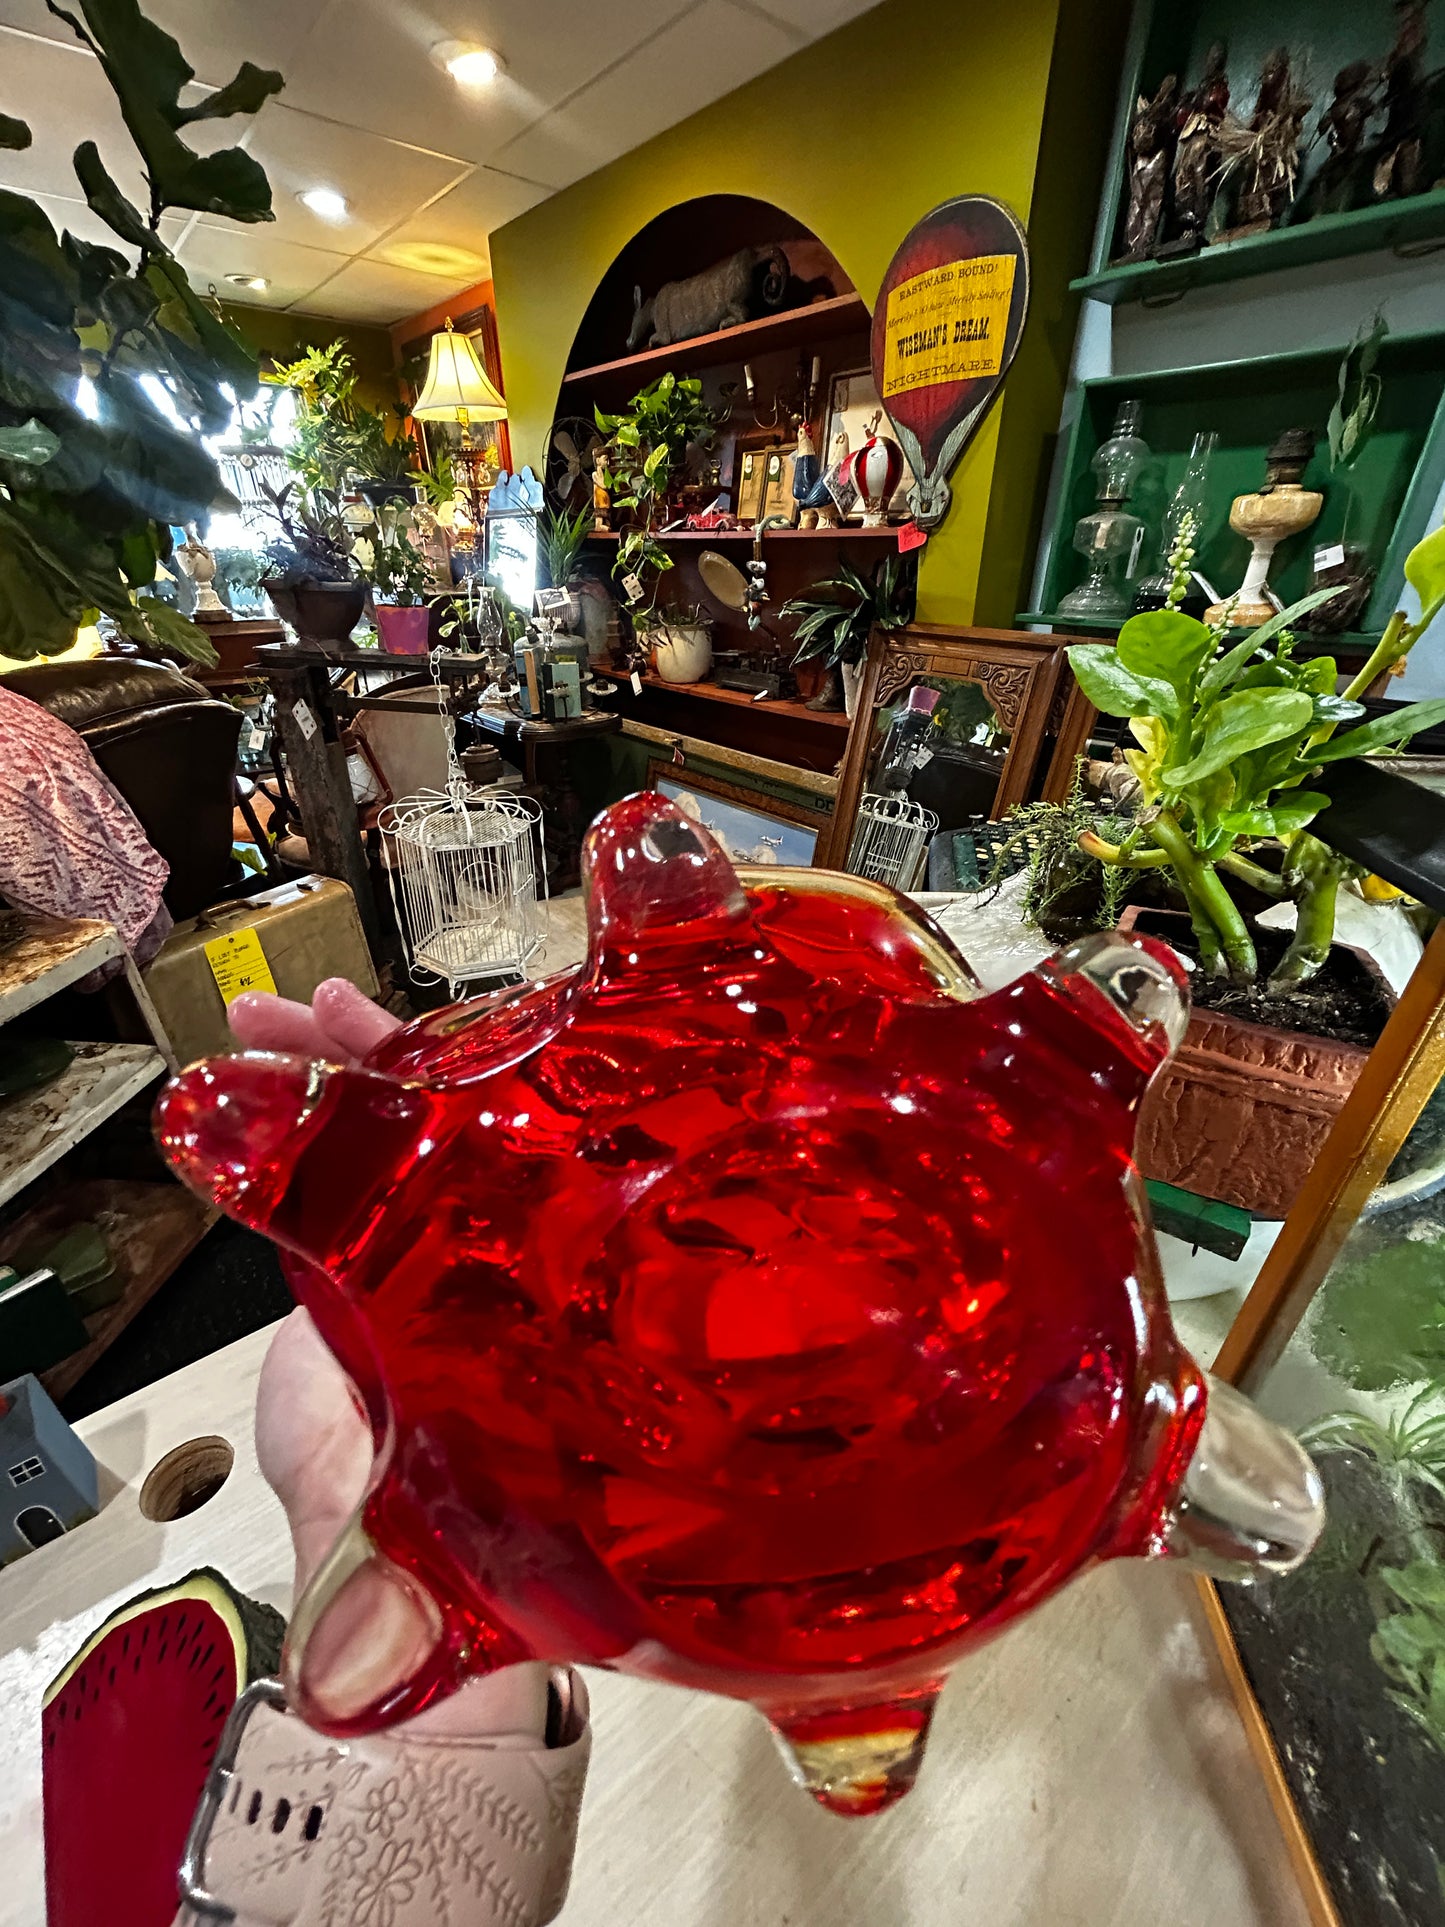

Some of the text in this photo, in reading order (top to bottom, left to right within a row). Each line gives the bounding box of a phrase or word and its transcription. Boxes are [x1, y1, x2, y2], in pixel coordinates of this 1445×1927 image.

[899, 263, 998, 301] EASTWARD BOUND!
[897, 316, 990, 360] WISEMAN'S DREAM.
[886, 359, 997, 392] NIGHTMARE.
